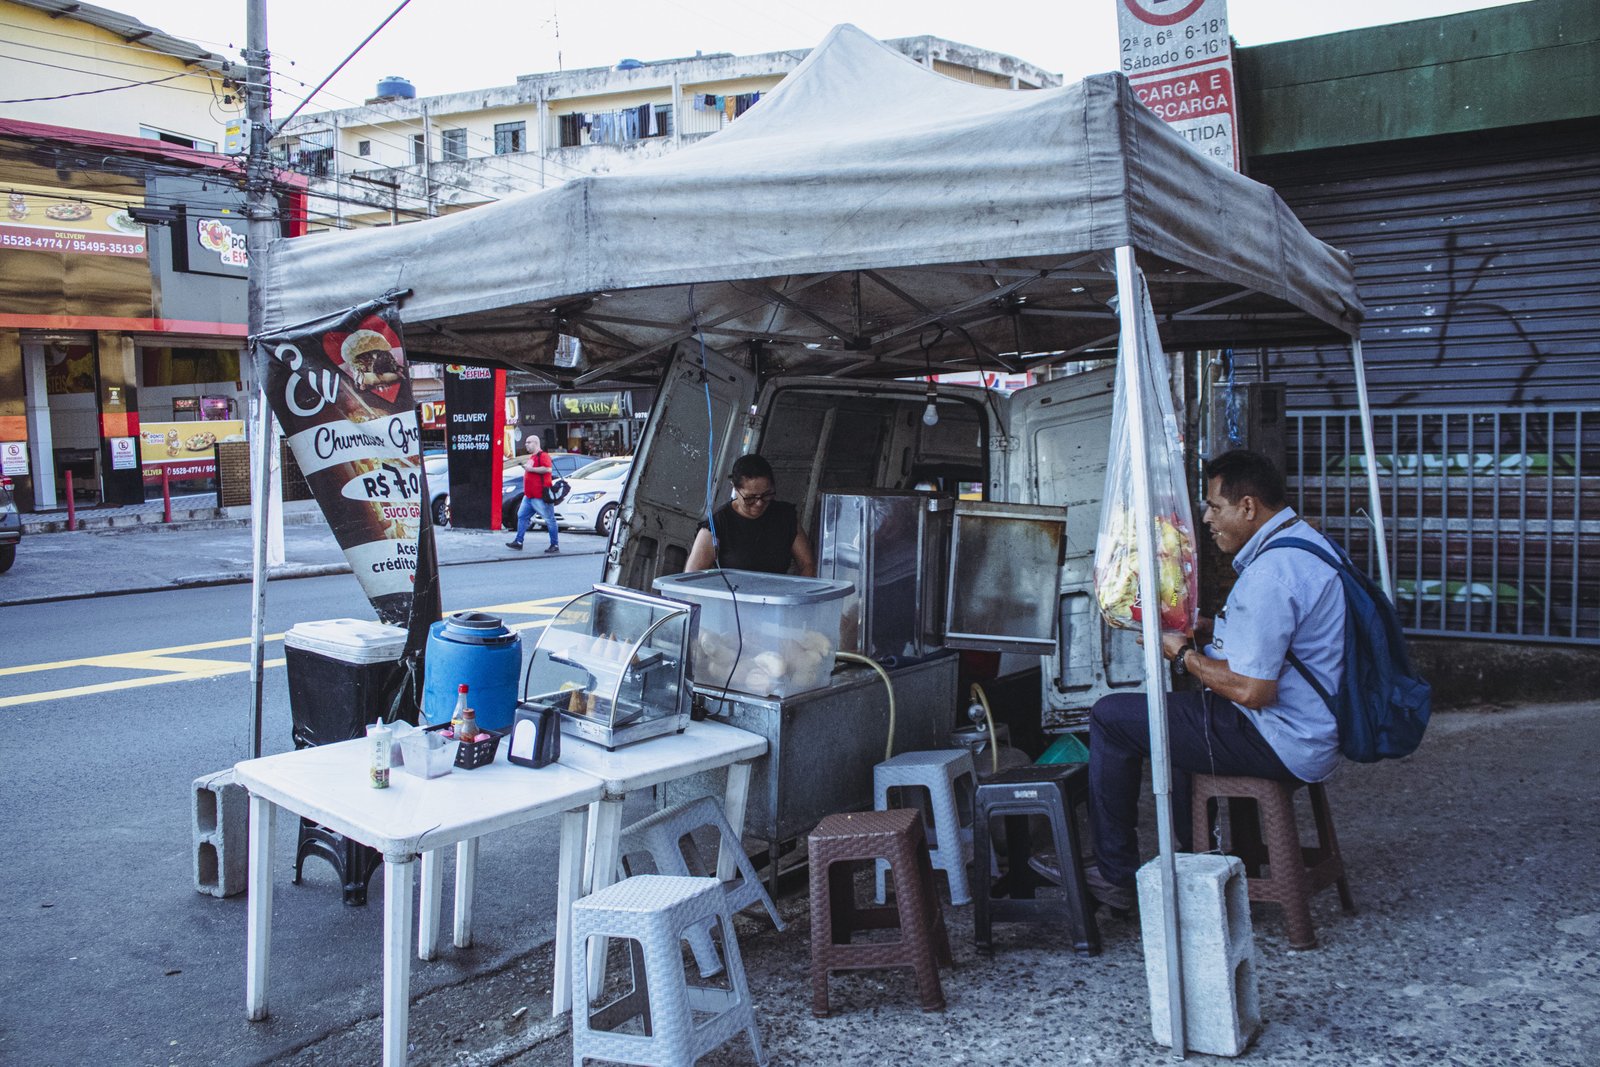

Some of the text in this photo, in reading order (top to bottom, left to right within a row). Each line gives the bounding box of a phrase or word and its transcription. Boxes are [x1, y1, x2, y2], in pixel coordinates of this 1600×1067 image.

[1122, 36, 1139, 52] 2ª
[1144, 37, 1152, 48] a
[1156, 30, 1172, 45] 6ª
[1123, 50, 1179, 71] Sábado
[1137, 74, 1221, 102] CARGA E
[1147, 93, 1228, 118] SCARGA
[55, 232, 86, 240] DELIVERY
[4, 235, 63, 249] 5528-4774
[74, 240, 134, 254] 95495-3513
[466, 370, 490, 378] ESFIHA
[582, 402, 610, 413] PARIS
[453, 413, 487, 422] DELIVERY
[458, 434, 490, 442] 5528-4774
[384, 508, 408, 518] SUCO
